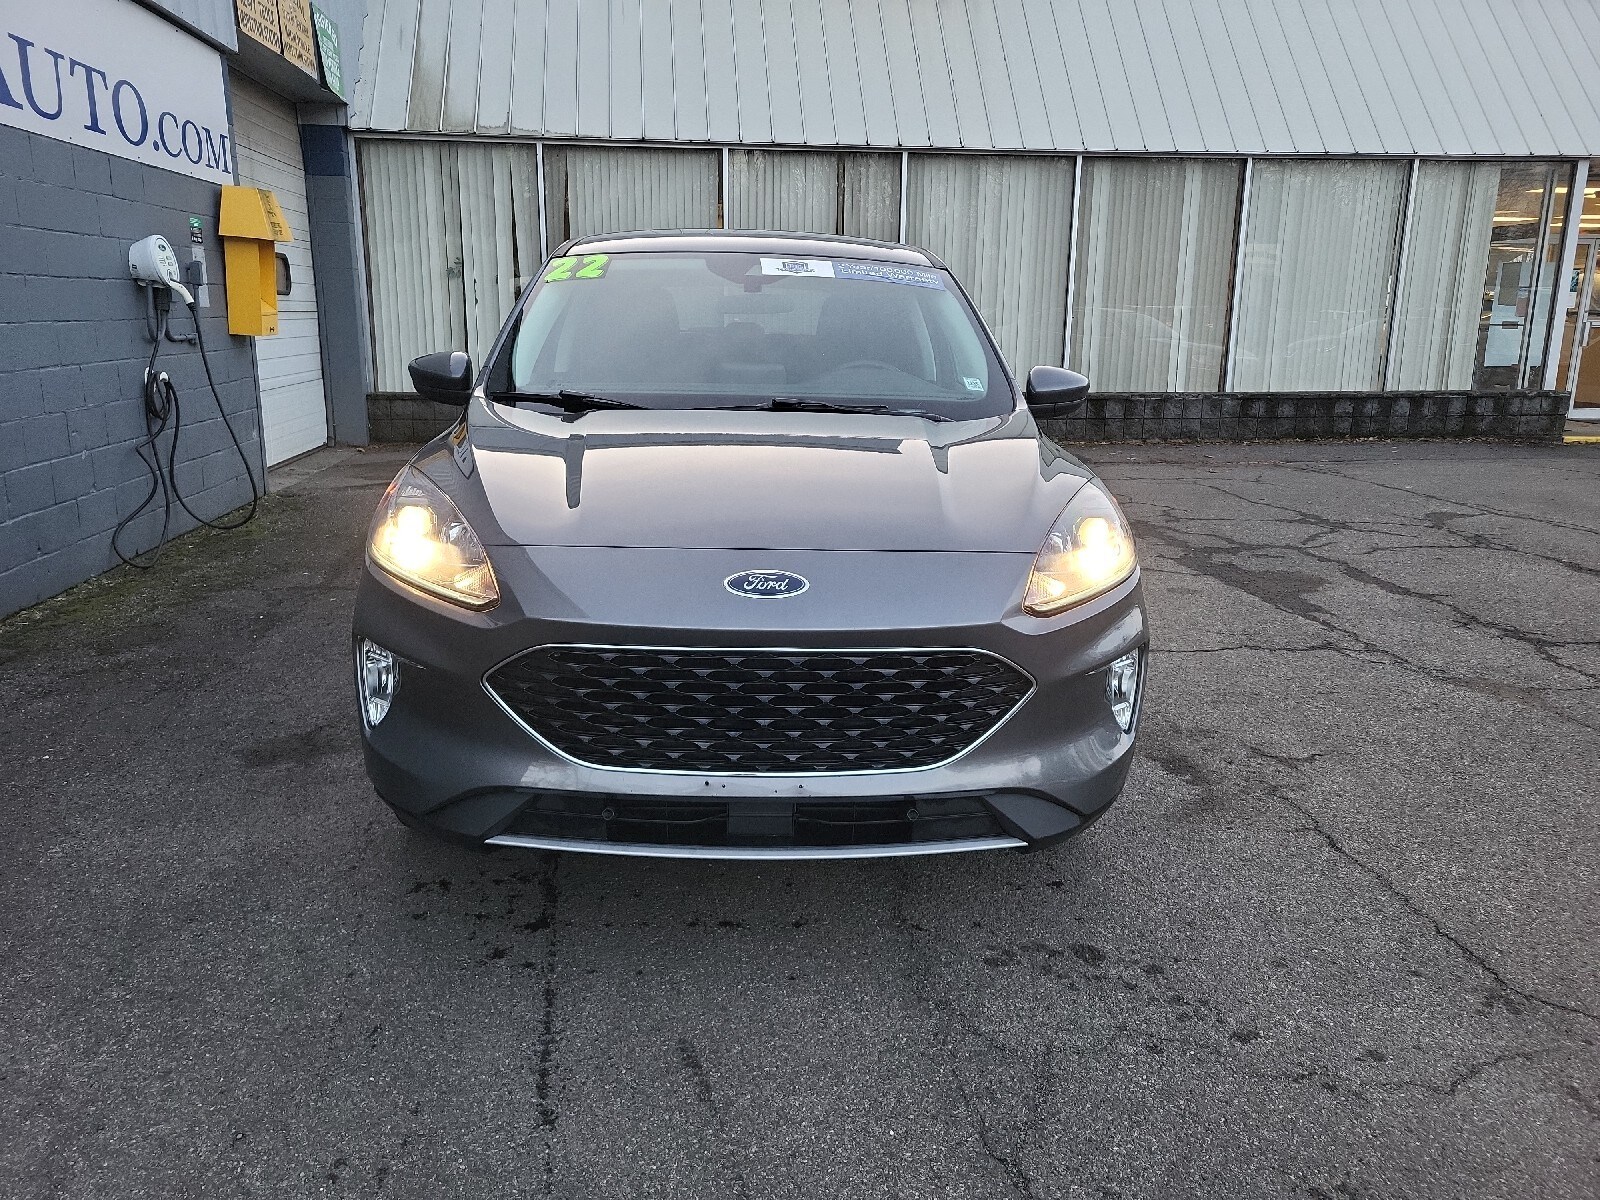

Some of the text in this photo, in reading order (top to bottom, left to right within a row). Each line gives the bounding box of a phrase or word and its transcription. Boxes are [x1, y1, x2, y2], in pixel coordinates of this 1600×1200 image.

[544, 254, 609, 282] 22
[841, 268, 883, 277] Limited
[743, 574, 789, 590] Ford
